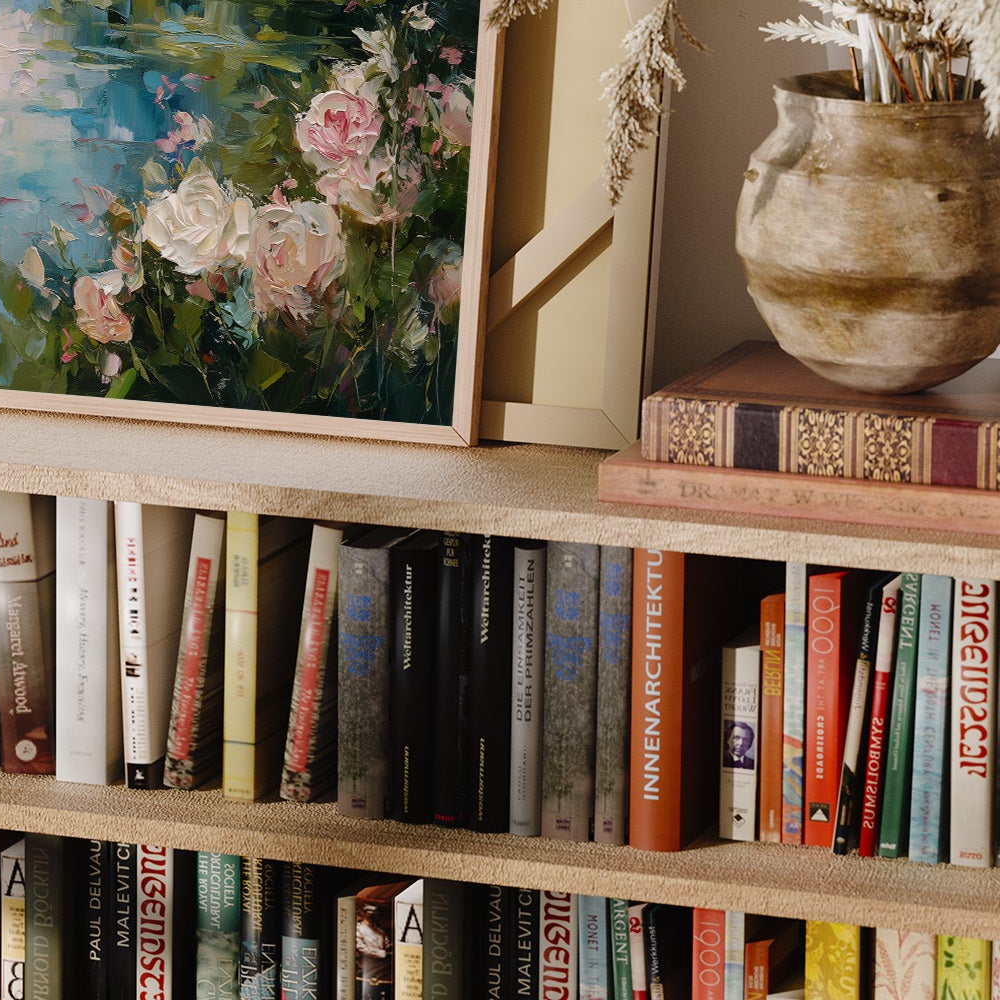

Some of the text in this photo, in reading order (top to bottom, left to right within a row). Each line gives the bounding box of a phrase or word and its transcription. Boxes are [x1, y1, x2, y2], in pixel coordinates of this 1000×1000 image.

[402, 563, 413, 671] Weltarchitektur
[516, 573, 525, 686] EINSAMKEIT
[524, 558, 535, 723] DER PRIMZAHLEN
[5, 594, 33, 714] Margaret Atwood
[402, 745, 411, 814] westermann
[477, 737, 486, 821] westermann
[89, 916, 101, 961] PAUL
[587, 914, 598, 952] MONET
[629, 916, 642, 934] 2
[648, 926, 660, 975] Werkkunst
[693, 922, 721, 986] 1900
